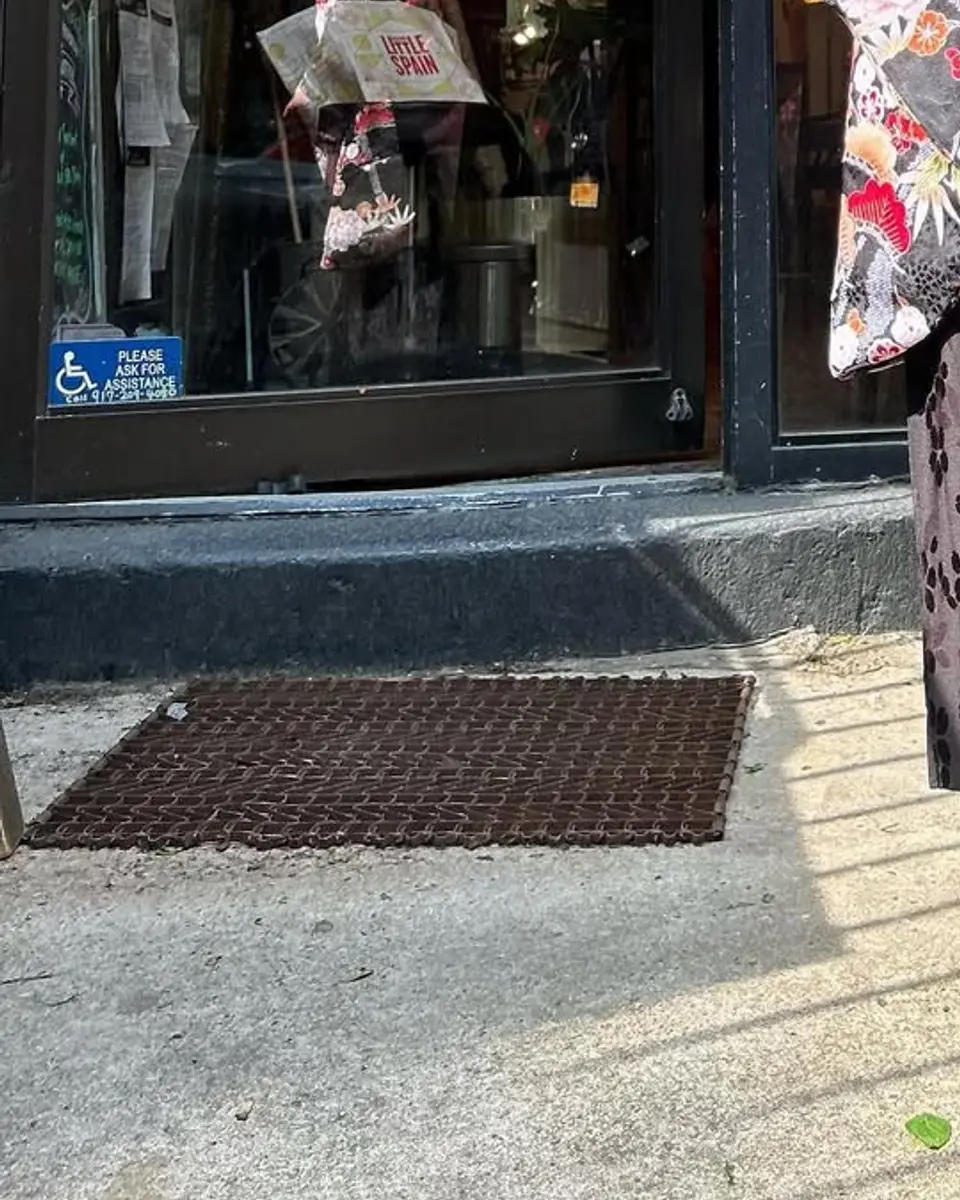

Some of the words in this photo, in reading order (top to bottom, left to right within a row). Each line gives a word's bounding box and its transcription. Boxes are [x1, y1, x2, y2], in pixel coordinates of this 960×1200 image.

[380, 33, 431, 54] LITTLE
[391, 54, 440, 76] SPAIN
[118, 349, 163, 362] PLEASE
[115, 365, 139, 376] ASK
[141, 363, 165, 375] FOR
[104, 376, 176, 391] ASSISTANCE
